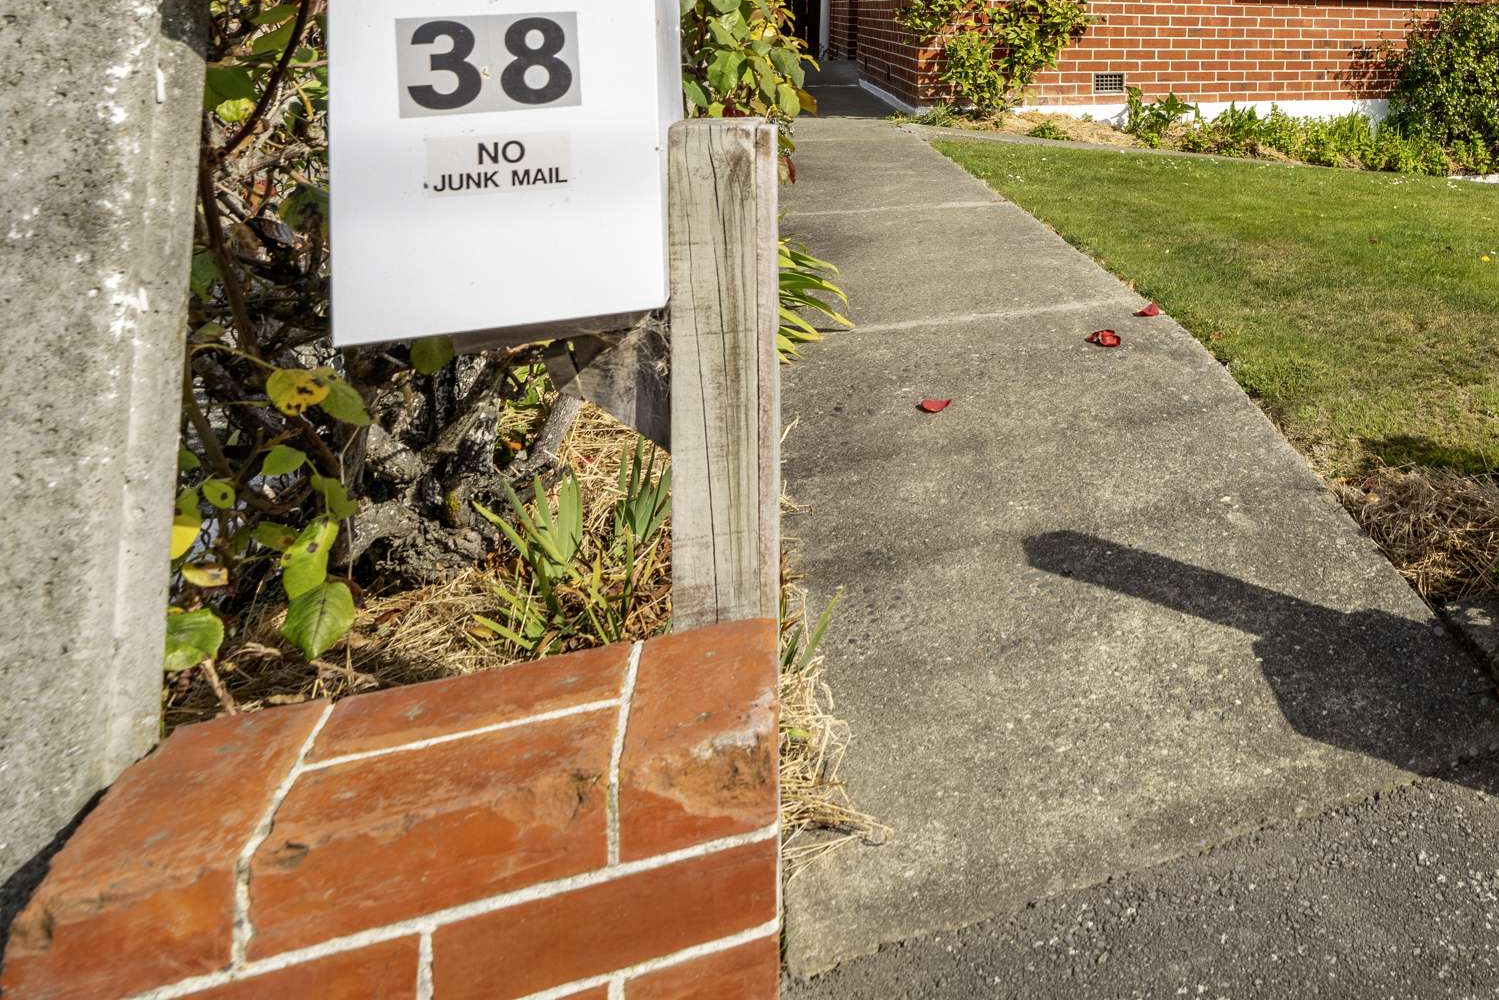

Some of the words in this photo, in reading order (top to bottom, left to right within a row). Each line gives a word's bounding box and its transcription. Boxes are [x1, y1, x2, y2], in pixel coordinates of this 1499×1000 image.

[407, 17, 573, 110] 38
[478, 140, 526, 165] NO
[433, 171, 499, 192] JUNK
[511, 167, 568, 187] MAIL
